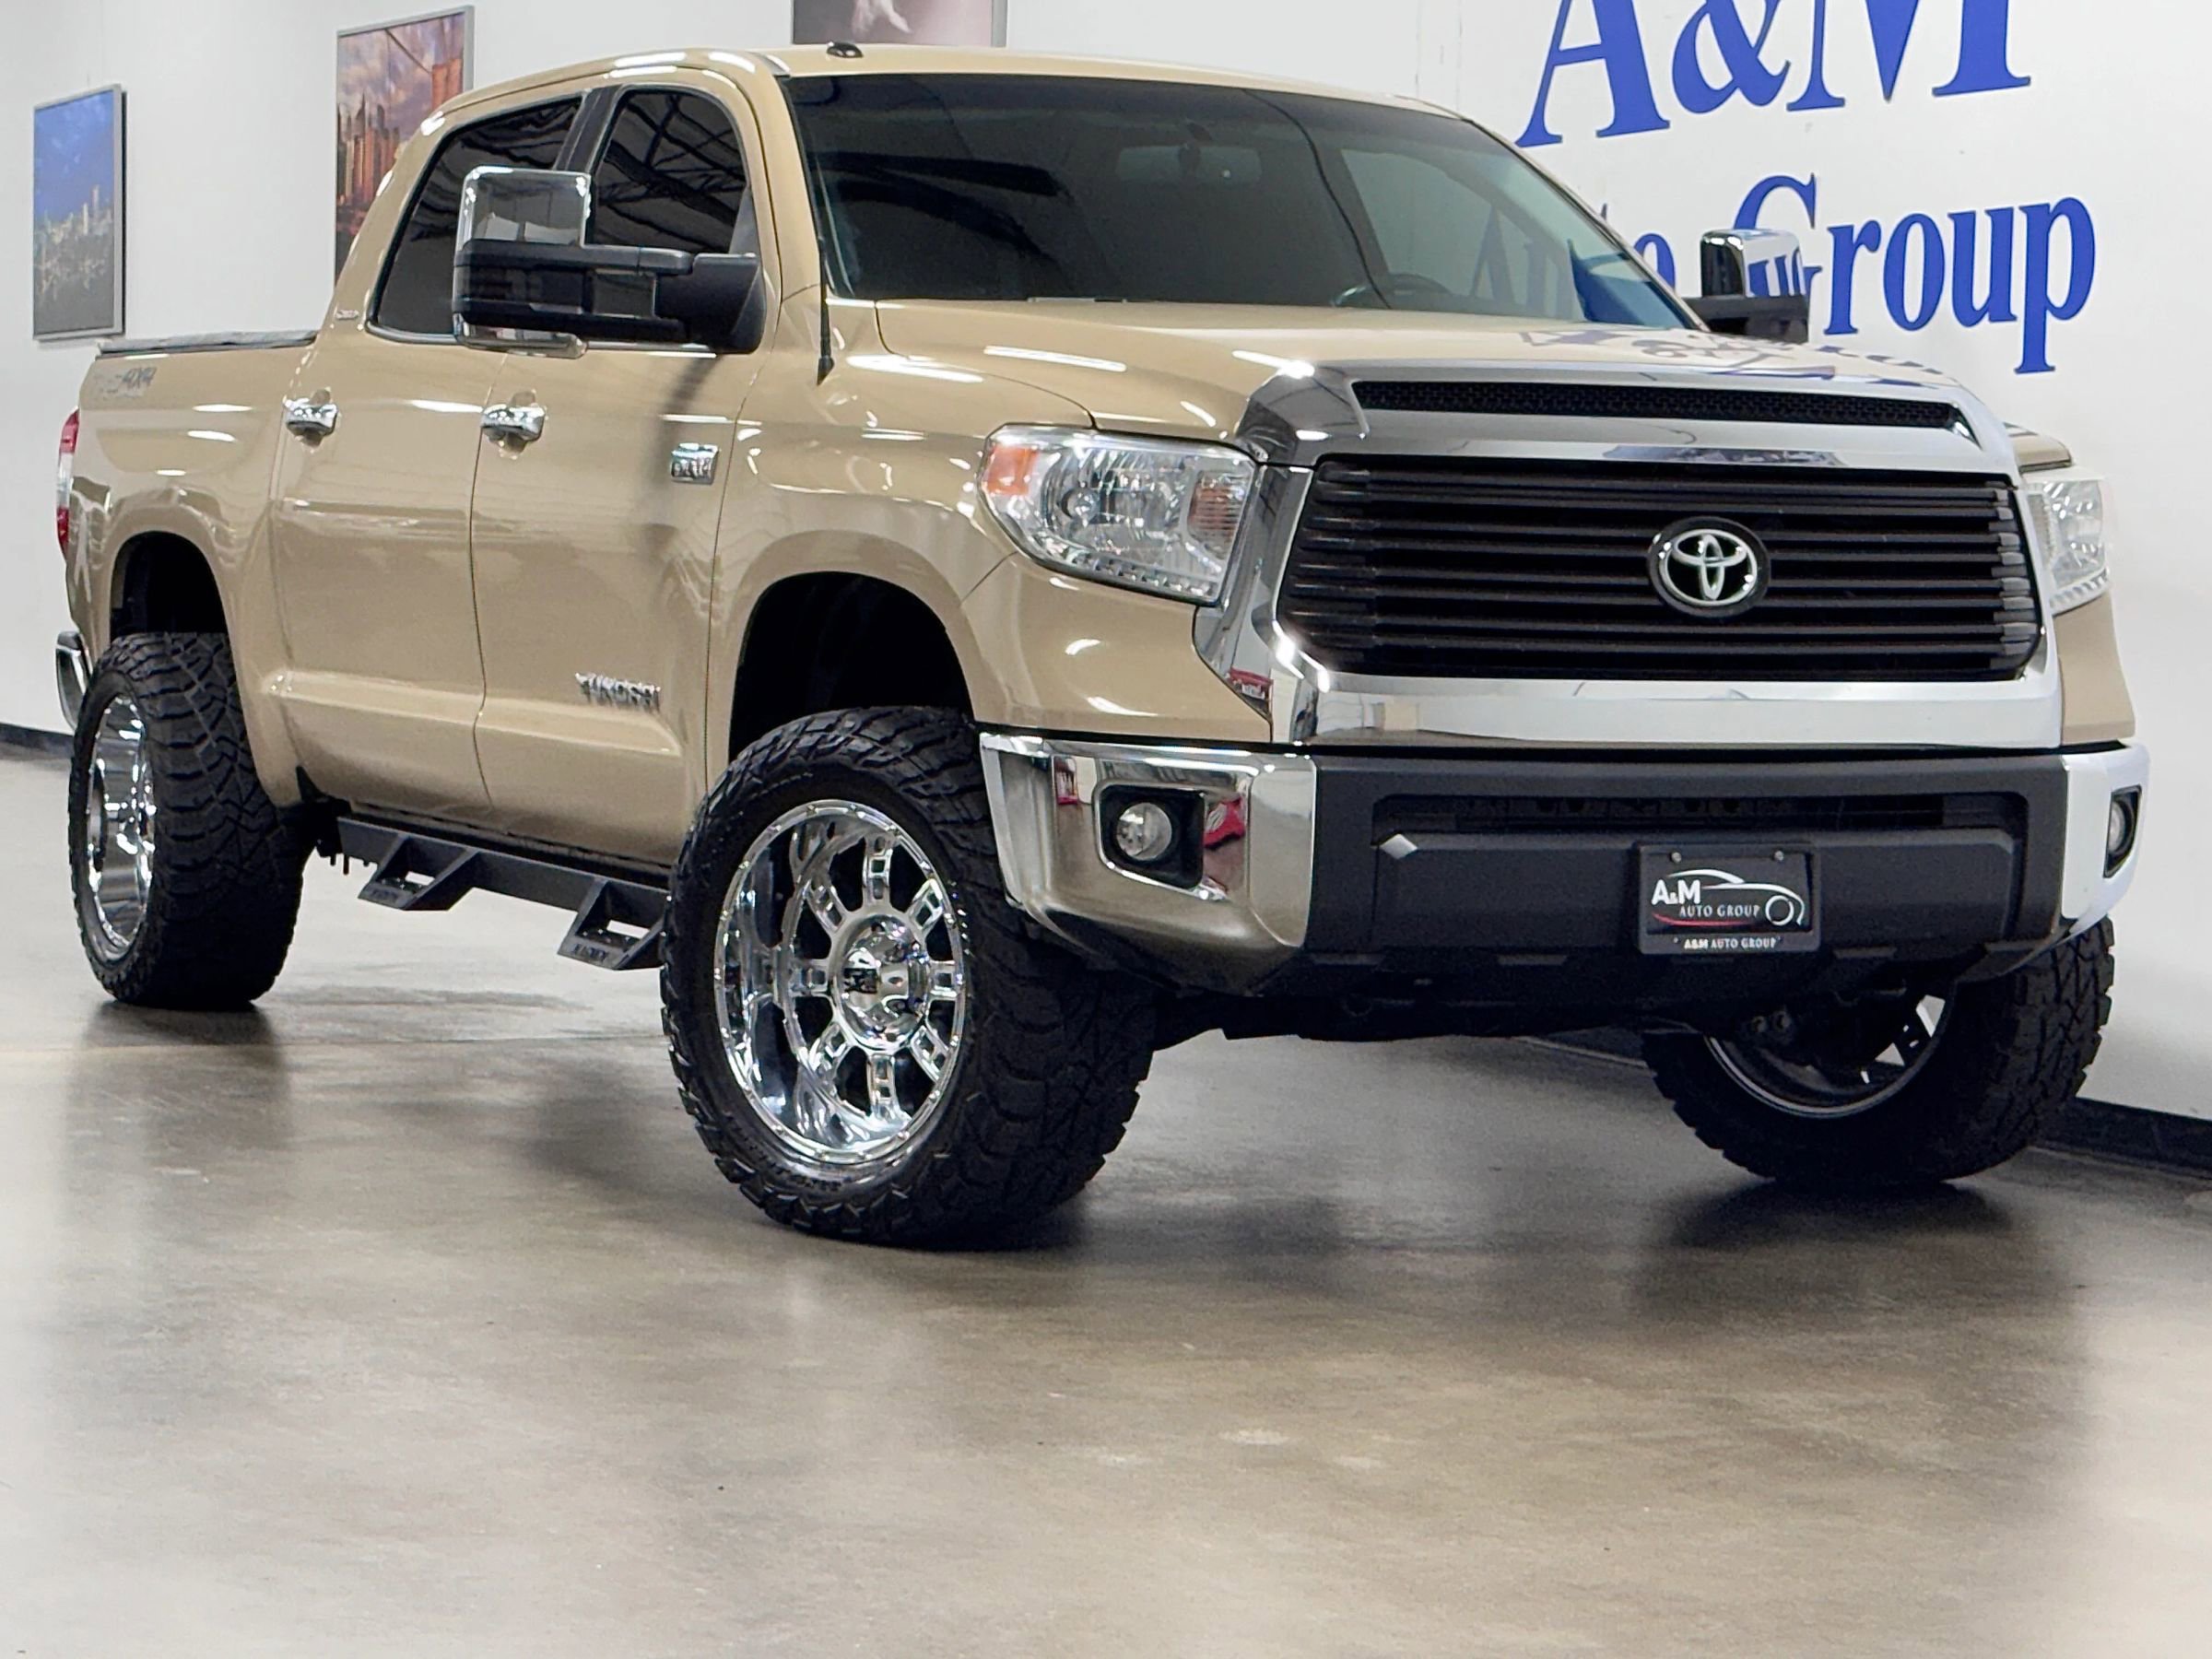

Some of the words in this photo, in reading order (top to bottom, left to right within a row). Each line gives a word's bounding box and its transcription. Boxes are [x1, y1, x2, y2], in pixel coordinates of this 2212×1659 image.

[1651, 878, 1701, 906] A&M
[1679, 904, 1713, 918] AUTO
[1716, 904, 1761, 918] GROUP
[1683, 937, 1709, 949] A&M
[1711, 937, 1739, 949] AUTO
[1740, 936, 1778, 948] GROUP
